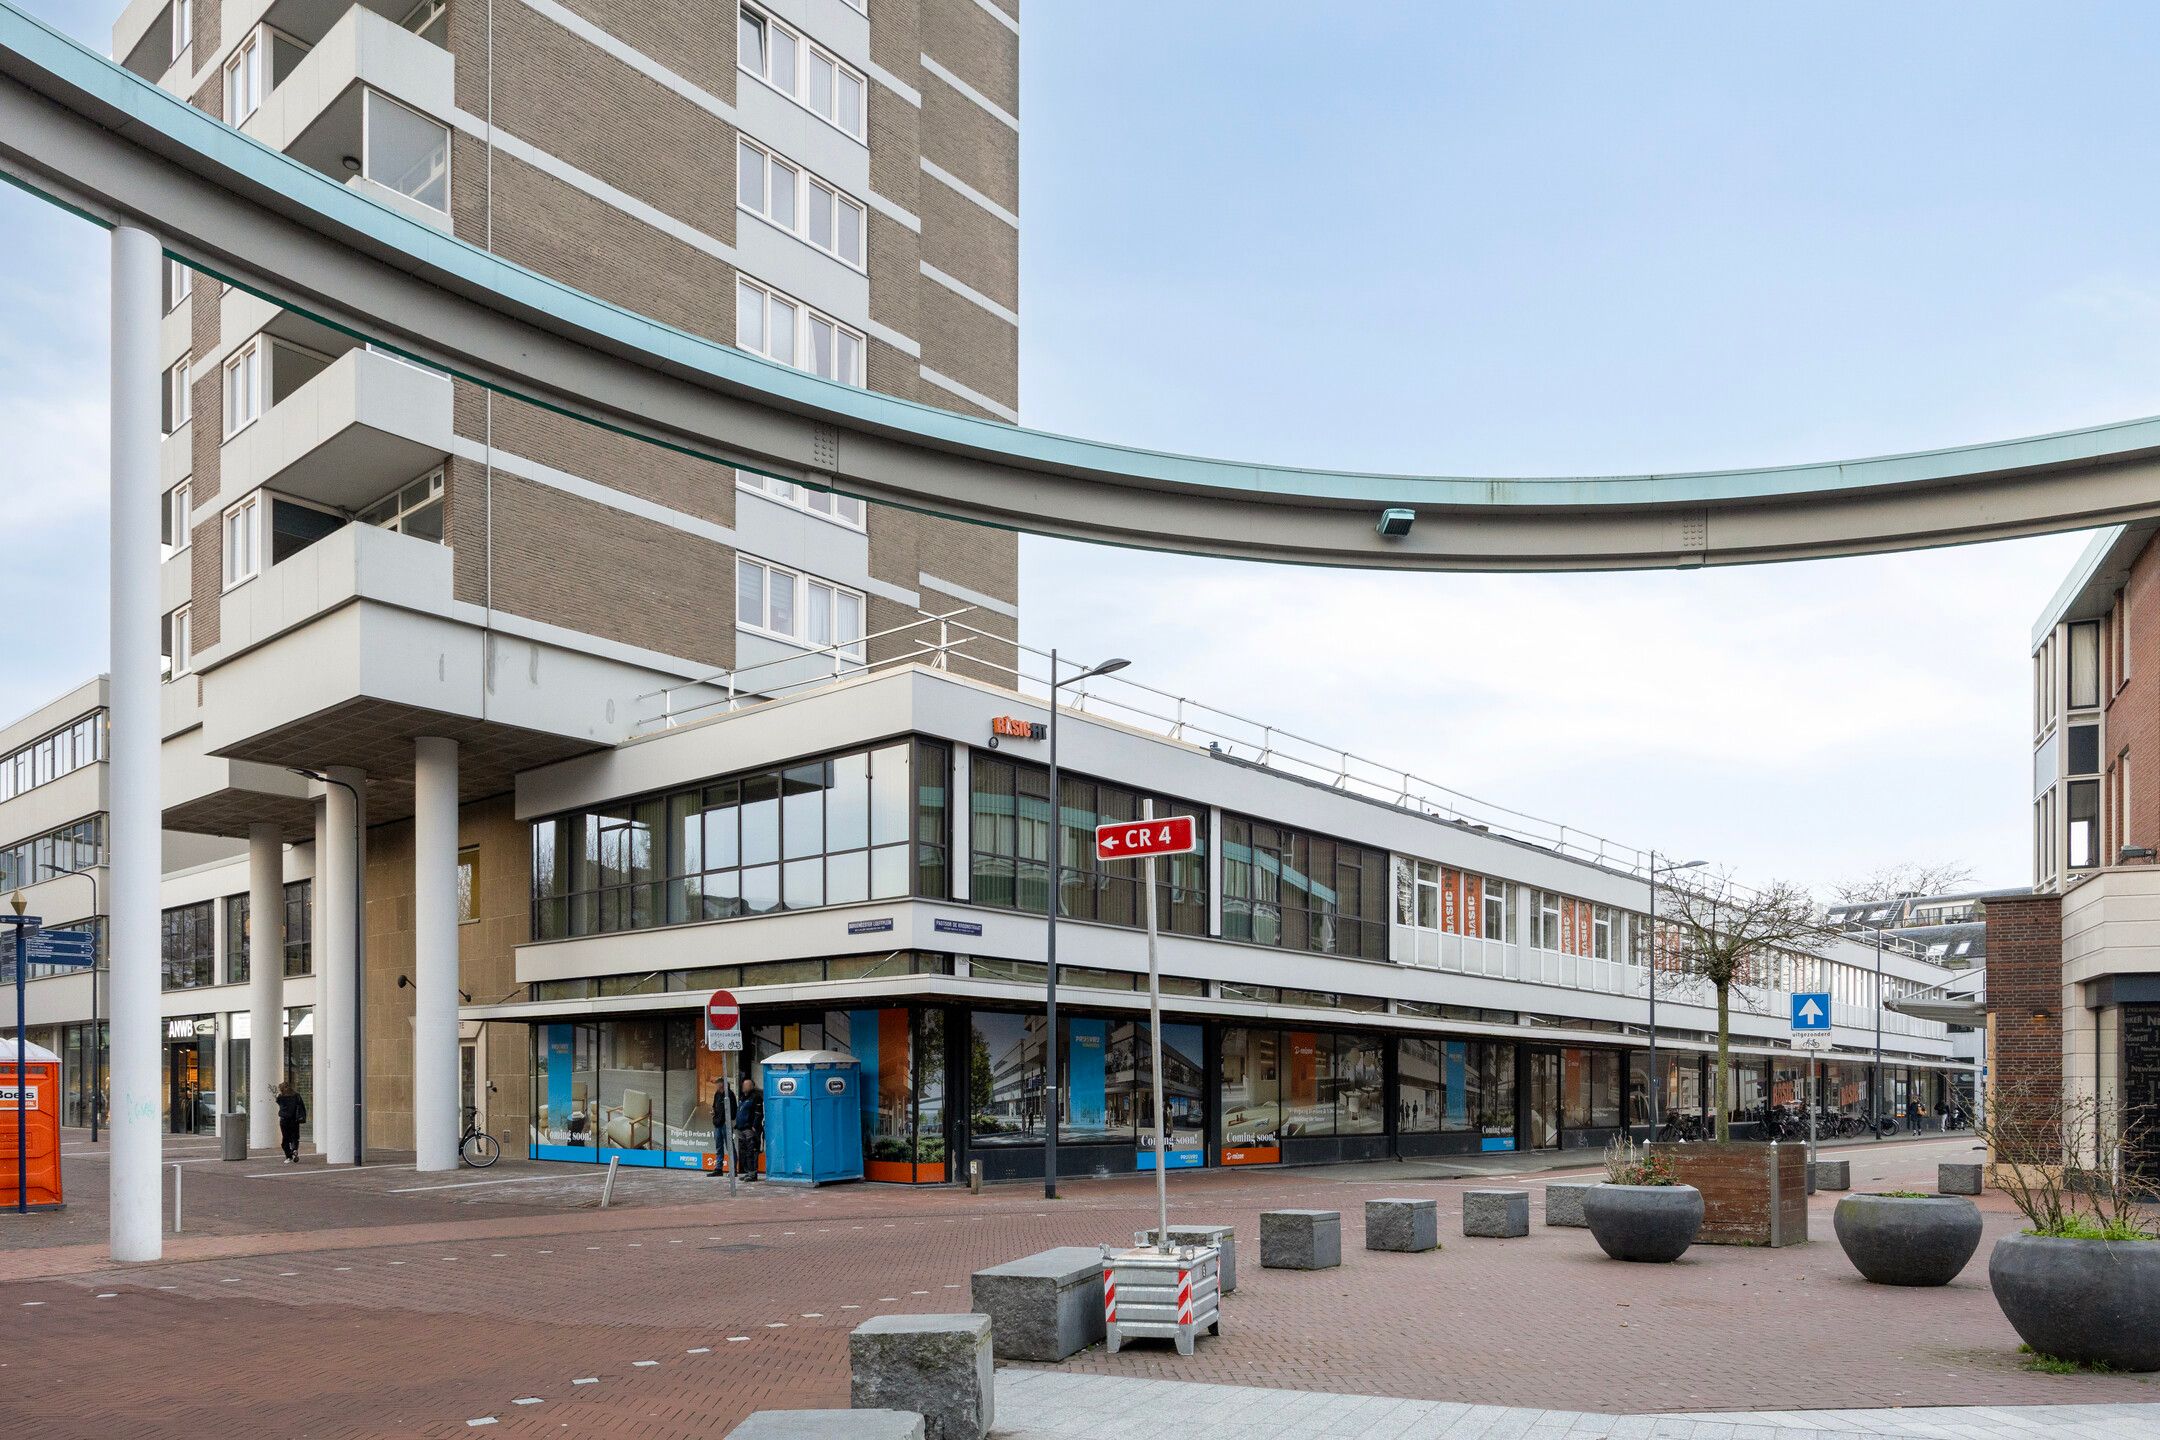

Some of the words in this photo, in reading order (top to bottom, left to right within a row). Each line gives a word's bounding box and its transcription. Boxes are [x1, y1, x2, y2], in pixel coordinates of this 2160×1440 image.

[992, 716, 1032, 737] BASIC
[1125, 828, 1152, 848] CR
[1158, 825, 1171, 844] 4
[1445, 890, 1454, 933] BASIC
[169, 1019, 193, 1038] ANWB
[544, 1129, 572, 1141] Coming
[572, 1130, 592, 1141] soon!
[1175, 1133, 1198, 1145] soon!
[1226, 1131, 1256, 1143] Coming
[1256, 1131, 1277, 1142] soon!
